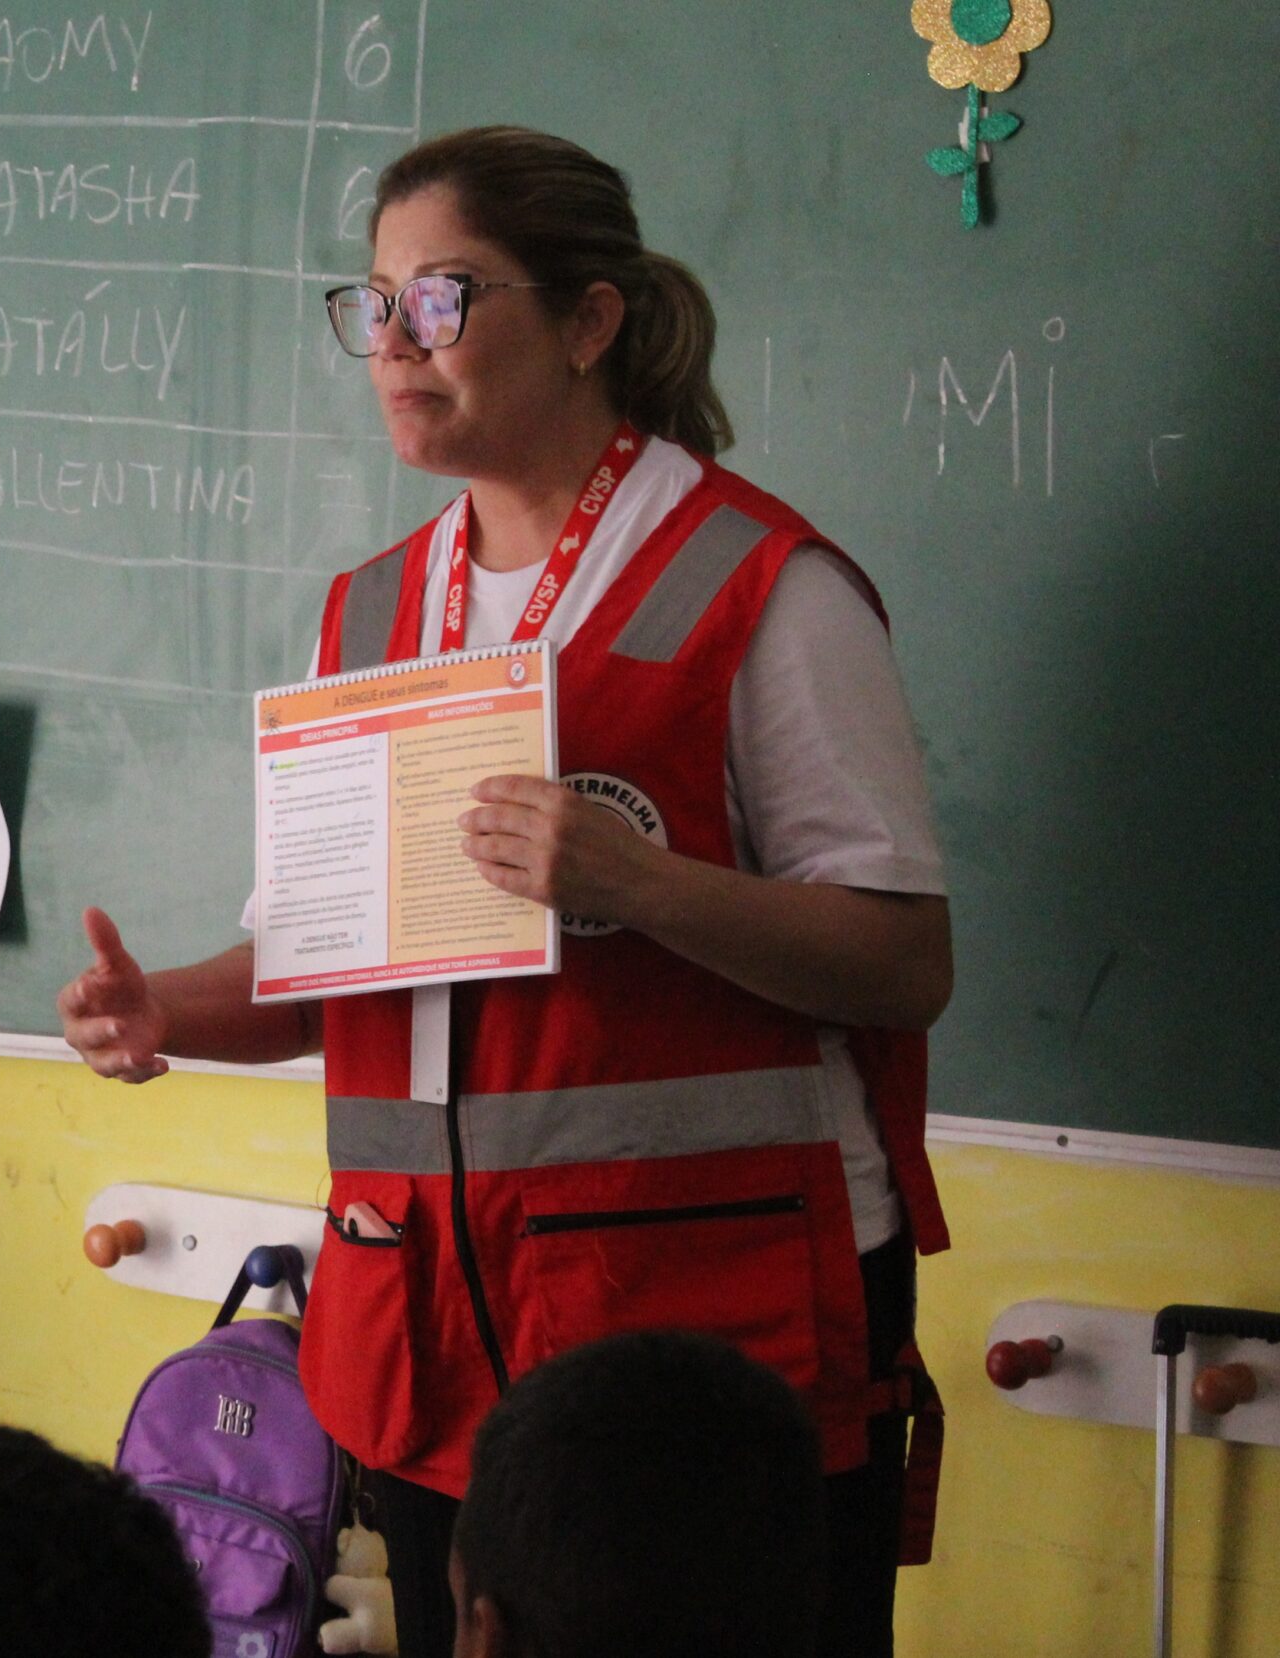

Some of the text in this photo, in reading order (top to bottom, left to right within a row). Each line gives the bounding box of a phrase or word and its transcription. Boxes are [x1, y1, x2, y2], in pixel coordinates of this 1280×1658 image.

[344, 14, 392, 91] 6
[579, 465, 617, 515] CVSP
[446, 583, 463, 632] CVSP
[524, 573, 560, 624] CVSP
[334, 699, 341, 708] A
[342, 690, 378, 708] DENGUE
[387, 686, 406, 698] seus
[407, 679, 449, 696] sintomas
[563, 779, 658, 835] ERMELHA
